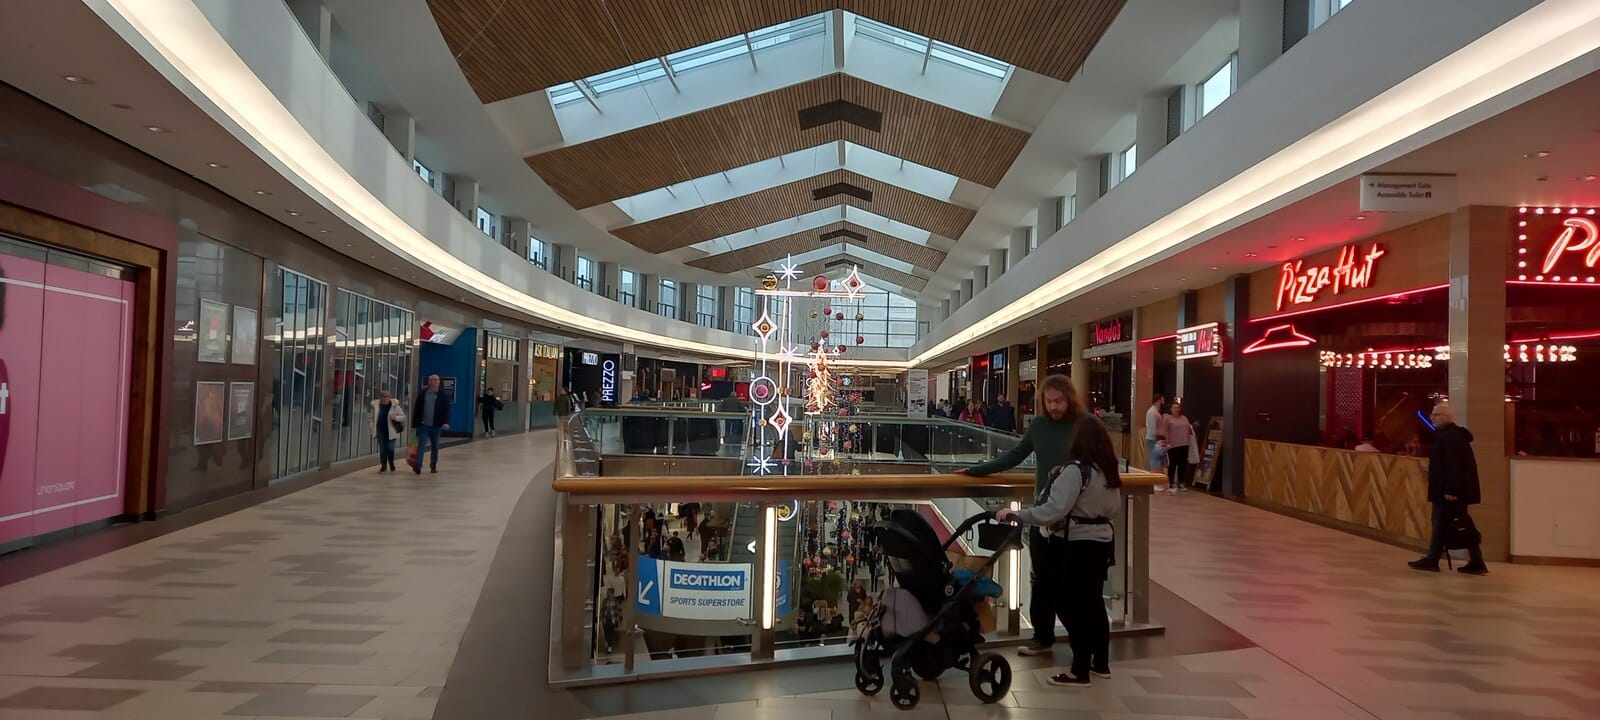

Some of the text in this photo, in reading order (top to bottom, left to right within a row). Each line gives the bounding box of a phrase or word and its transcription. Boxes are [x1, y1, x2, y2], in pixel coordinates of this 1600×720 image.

[1376, 181, 1432, 190] Management Suite
[1277, 243, 1385, 311] Pizza Hut
[1095, 316, 1121, 345] Nando's
[534, 343, 559, 359] ASK ITALIAN
[602, 360, 615, 402] PREZZO
[673, 572, 741, 587] DECATHLON
[670, 596, 746, 607] SPORTS SUPERSTORE
